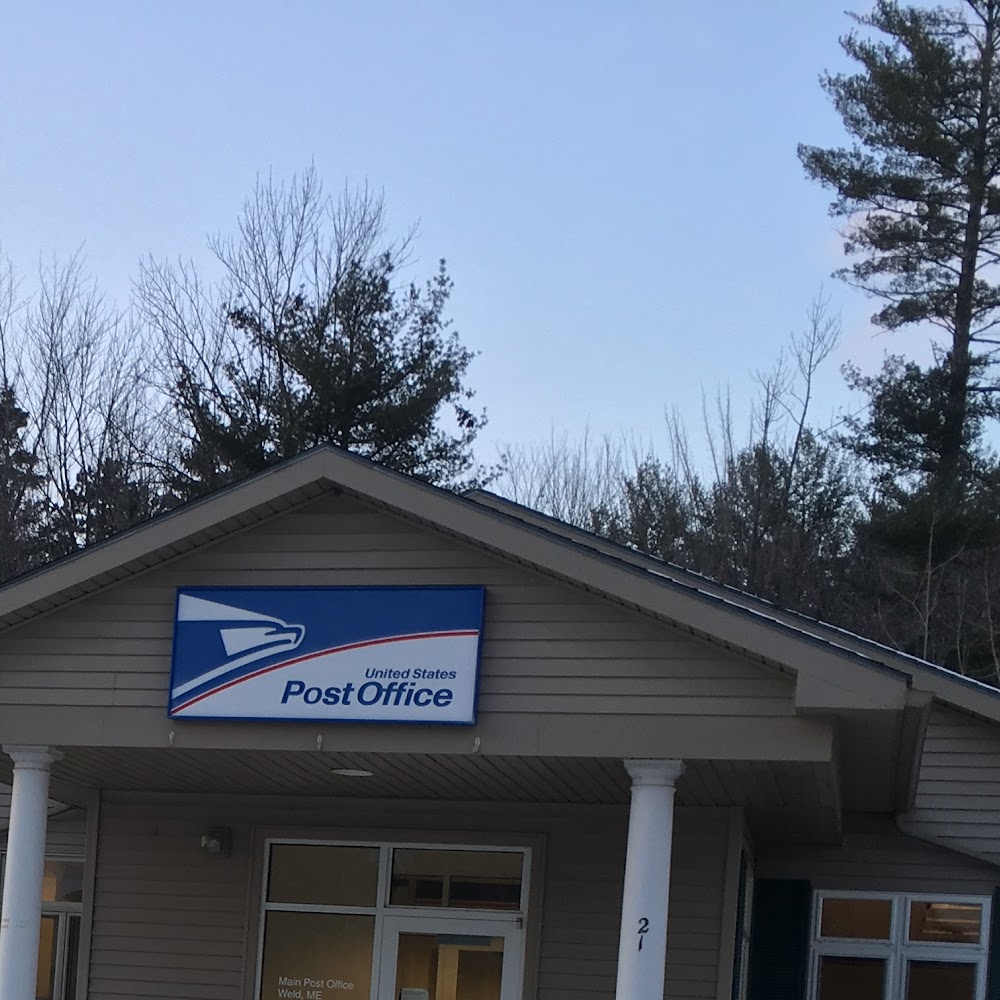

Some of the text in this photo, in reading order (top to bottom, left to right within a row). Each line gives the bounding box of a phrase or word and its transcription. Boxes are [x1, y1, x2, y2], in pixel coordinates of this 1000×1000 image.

[365, 668, 457, 680] United States
[281, 680, 453, 708] Post Office
[278, 977, 354, 990] Main Post Office
[278, 989, 322, 1000] Weld, ME
